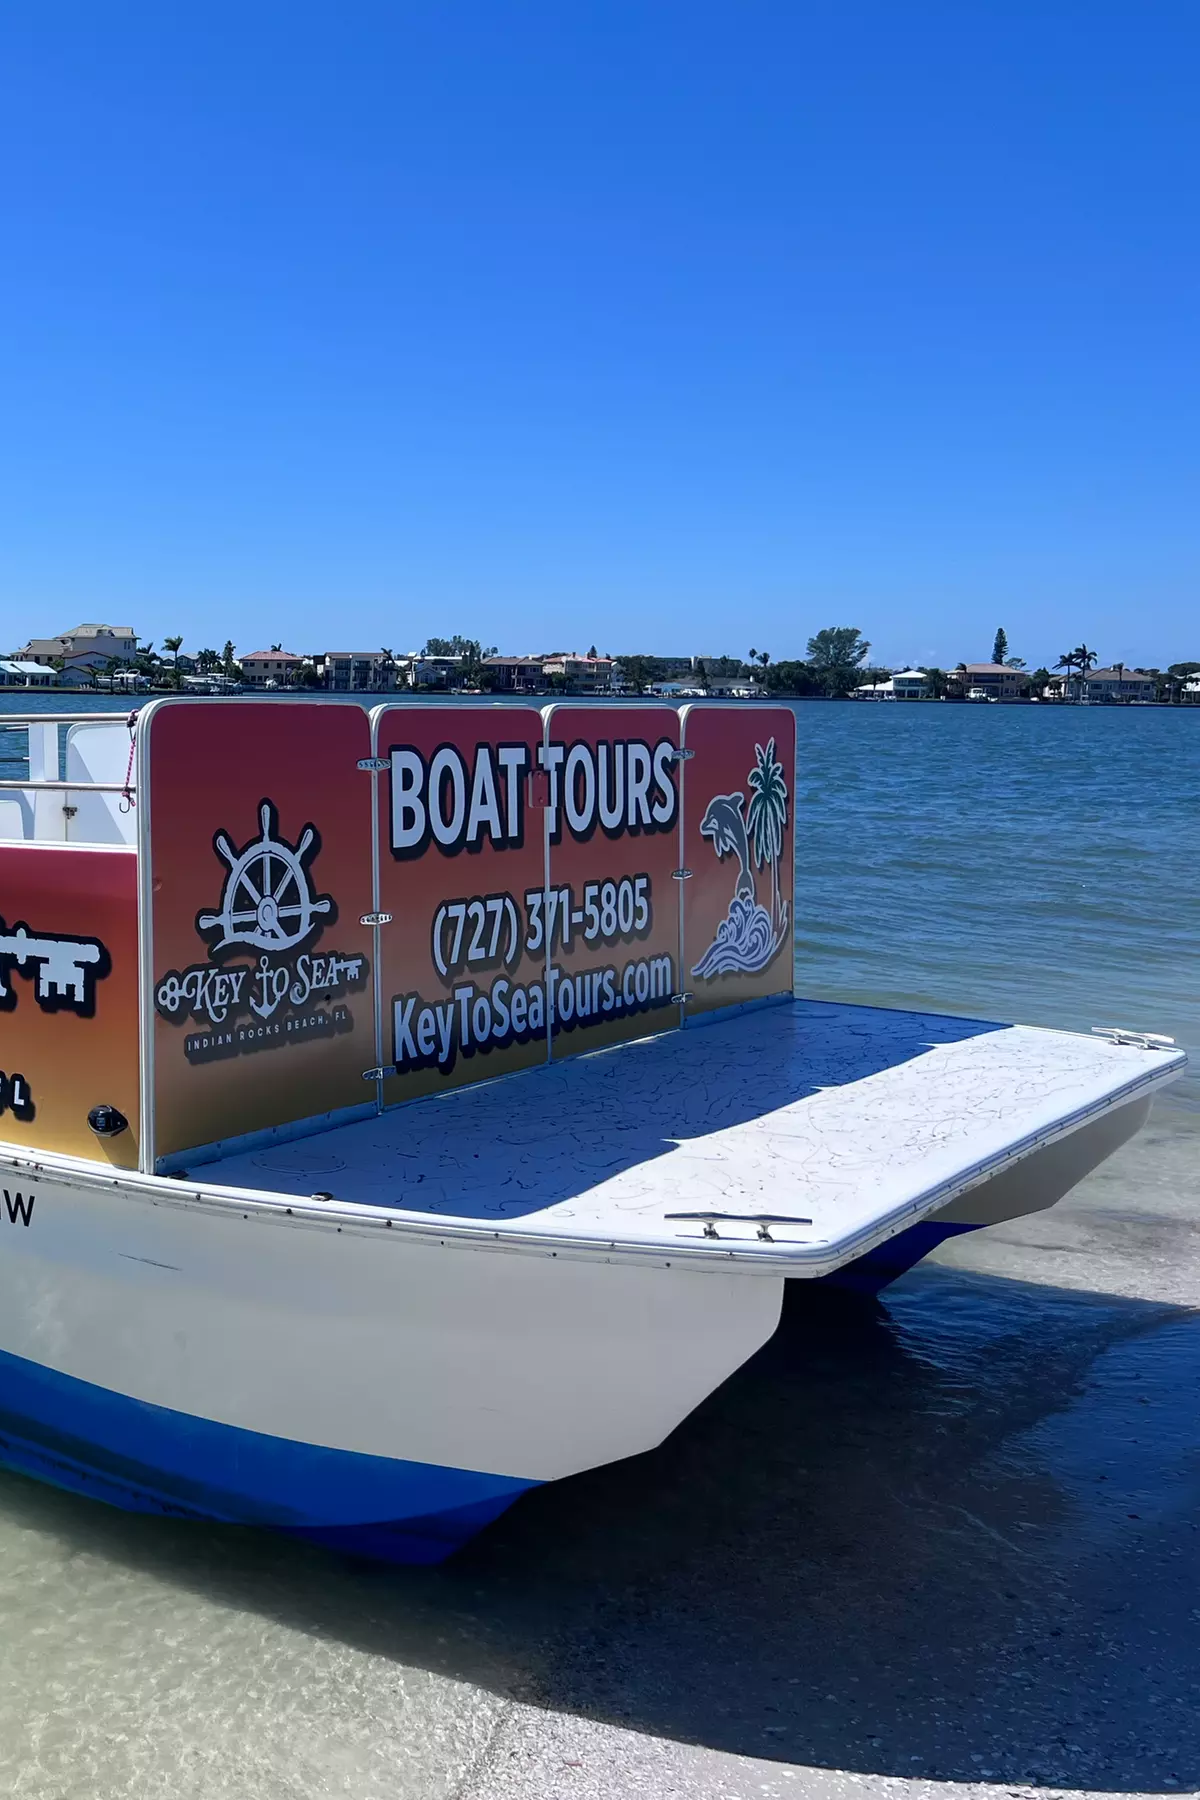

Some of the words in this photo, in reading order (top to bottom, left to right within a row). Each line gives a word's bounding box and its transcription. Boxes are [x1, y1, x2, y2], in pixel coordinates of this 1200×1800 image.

[392, 747, 526, 848] BOAT
[537, 741, 675, 833] TOURS
[433, 896, 517, 976] (727)
[526, 877, 649, 952] 371-5805
[187, 1032, 233, 1051] INDIAN
[239, 1023, 280, 1041] ROCKS
[287, 1013, 329, 1031] BEACH,
[335, 1011, 347, 1021] FL
[393, 955, 672, 1064] KeyToSeaTours.com
